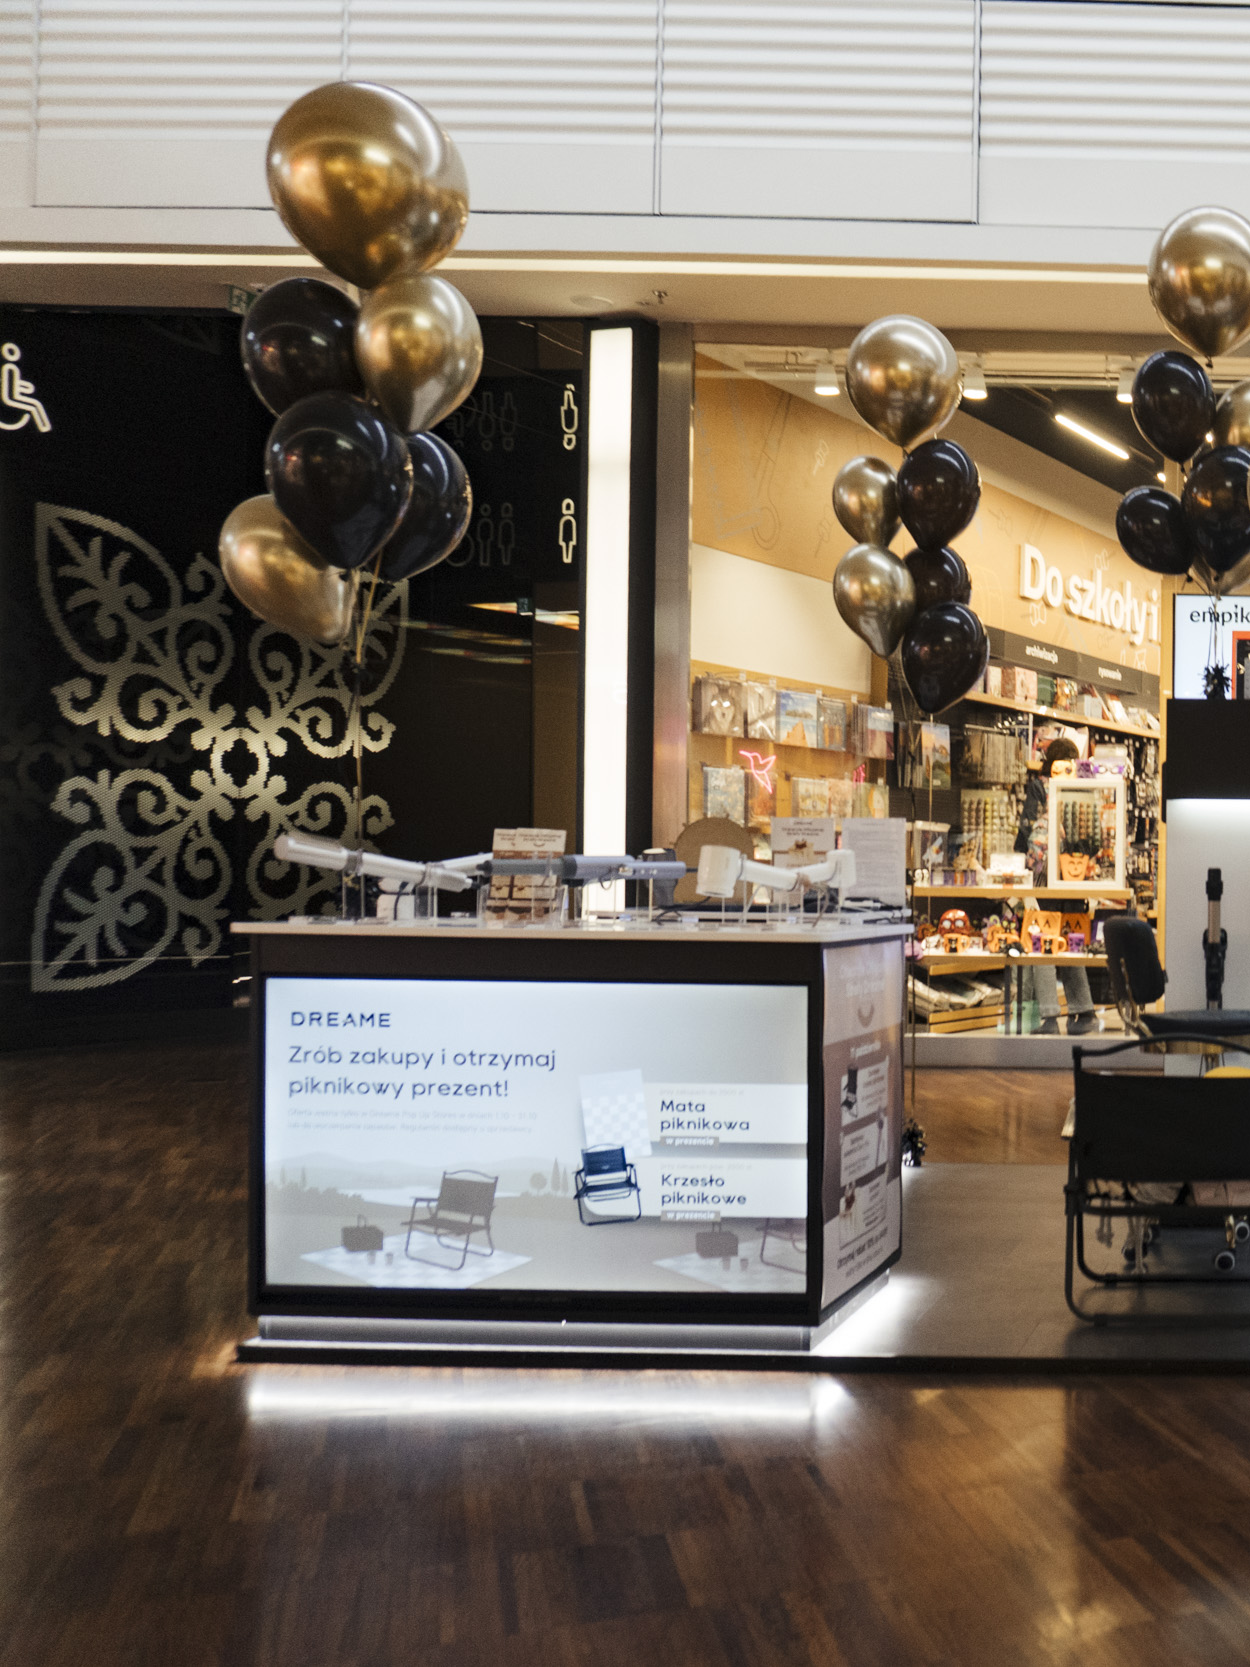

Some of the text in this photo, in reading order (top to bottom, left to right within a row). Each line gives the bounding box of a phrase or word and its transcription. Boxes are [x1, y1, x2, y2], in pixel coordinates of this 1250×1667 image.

[1020, 543, 1063, 607] Do
[1066, 569, 1147, 646] szkoły
[1189, 605, 1250, 627] empik
[291, 1011, 391, 1028] DREAME
[288, 1045, 556, 1072] Zrób zakupy i otrzymaj
[288, 1077, 509, 1099] piknikowy prezent!
[660, 1100, 706, 1112] Mata
[660, 1117, 750, 1132] piknikowa
[665, 1137, 715, 1147] w prezencie
[661, 1174, 725, 1187] Krzesło
[661, 1191, 747, 1206] piknikowe
[666, 1211, 716, 1221] w prezencie
